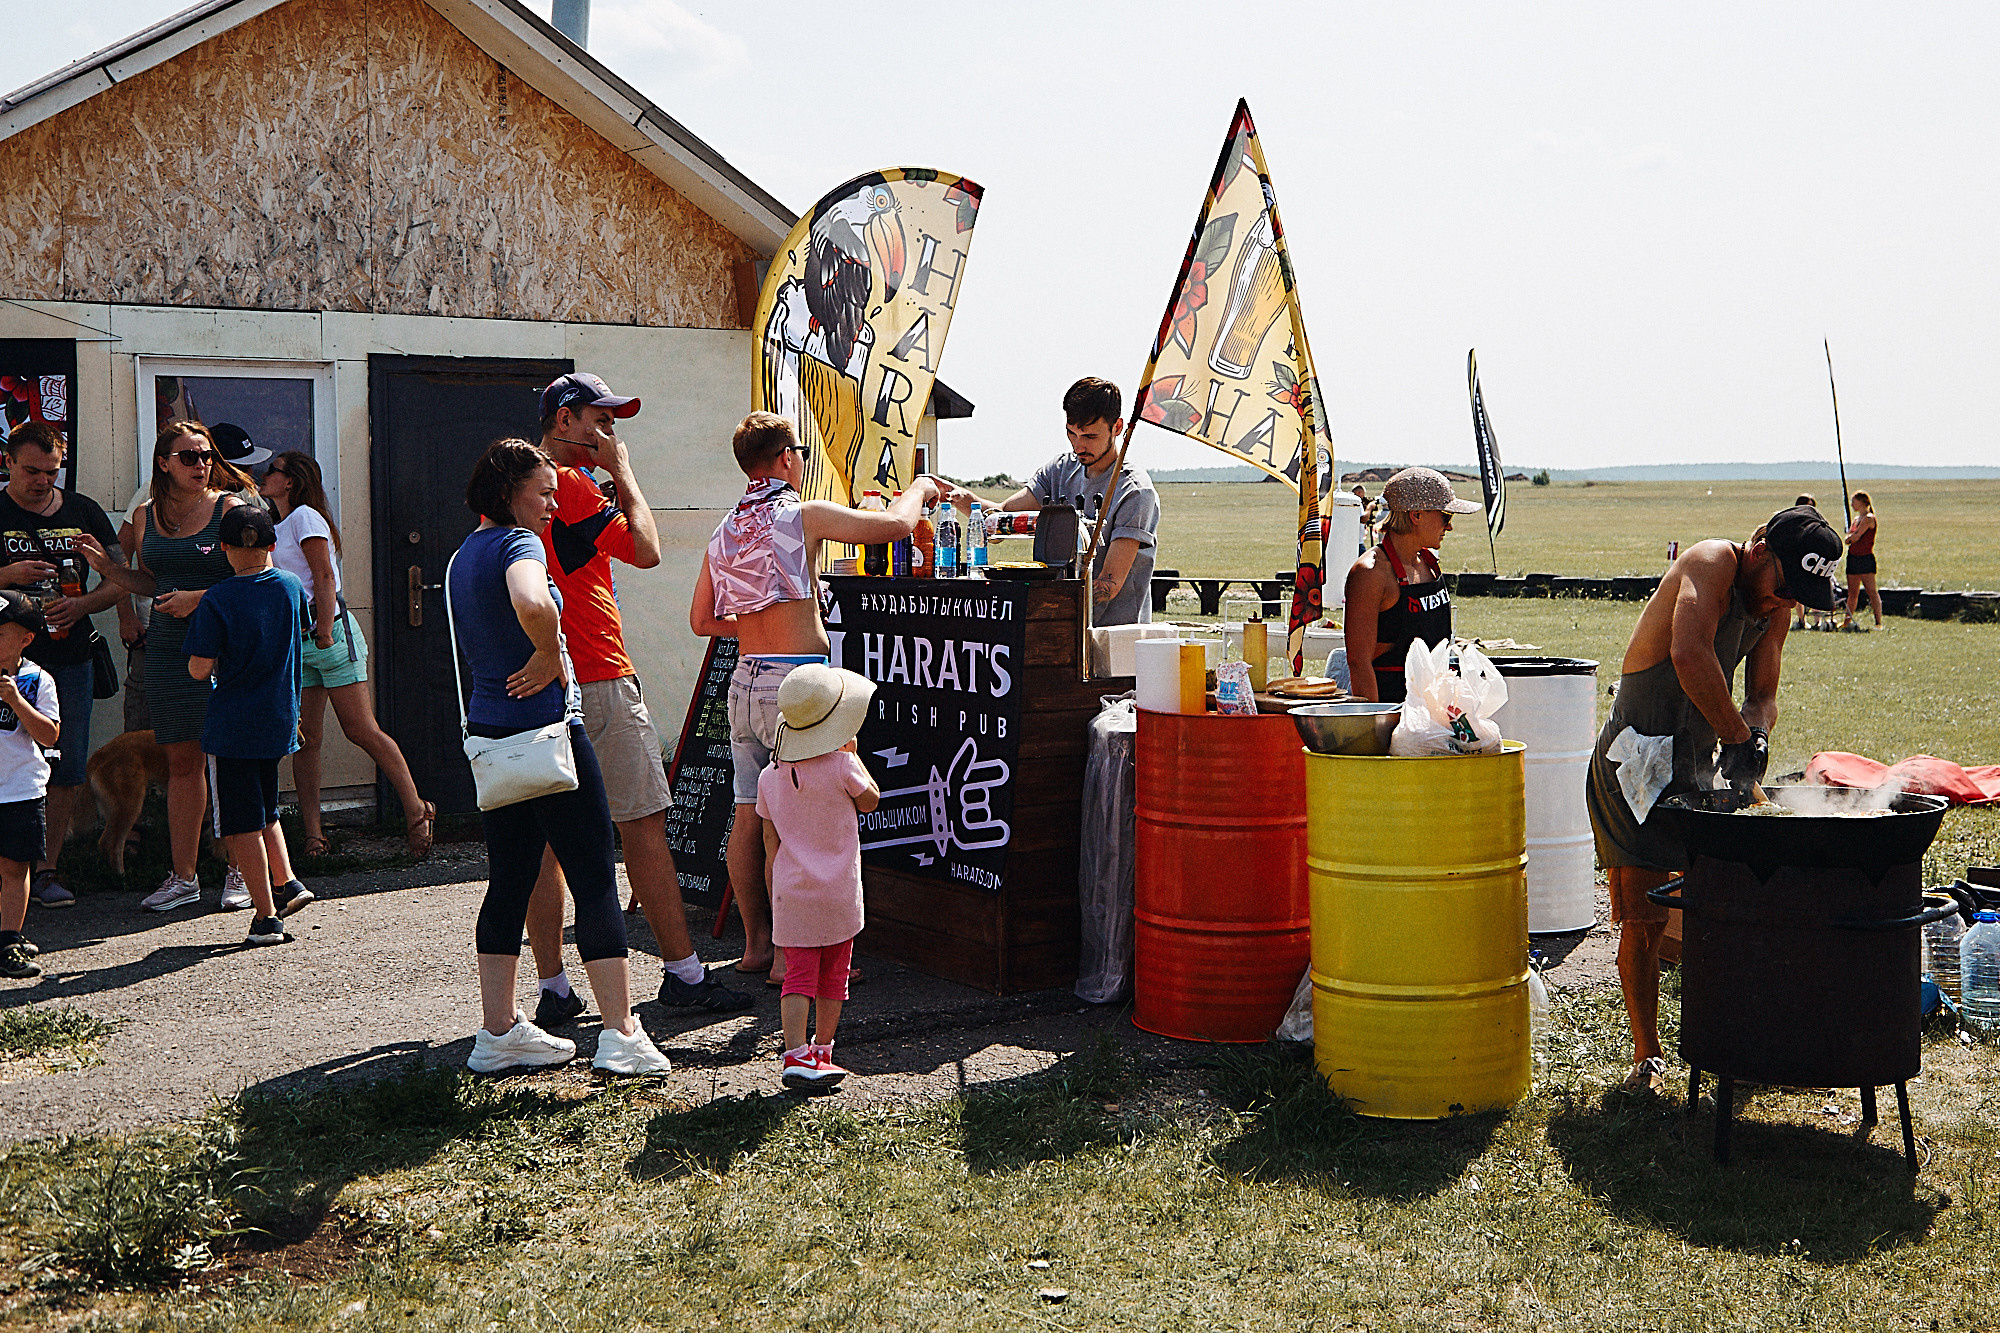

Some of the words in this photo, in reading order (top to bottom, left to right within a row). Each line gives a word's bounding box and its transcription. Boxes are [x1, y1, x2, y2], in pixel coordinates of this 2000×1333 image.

[871, 233, 967, 509] HARA
[7, 537, 78, 553] COLRAD
[861, 593, 1013, 621] #КУДАБЫТЫНИШЁЛ
[862, 632, 1012, 698] HARAT'S
[879, 699, 937, 728] RISH
[959, 710, 1007, 739] PUB
[859, 804, 927, 832] РОЛЬЩИКОМ
